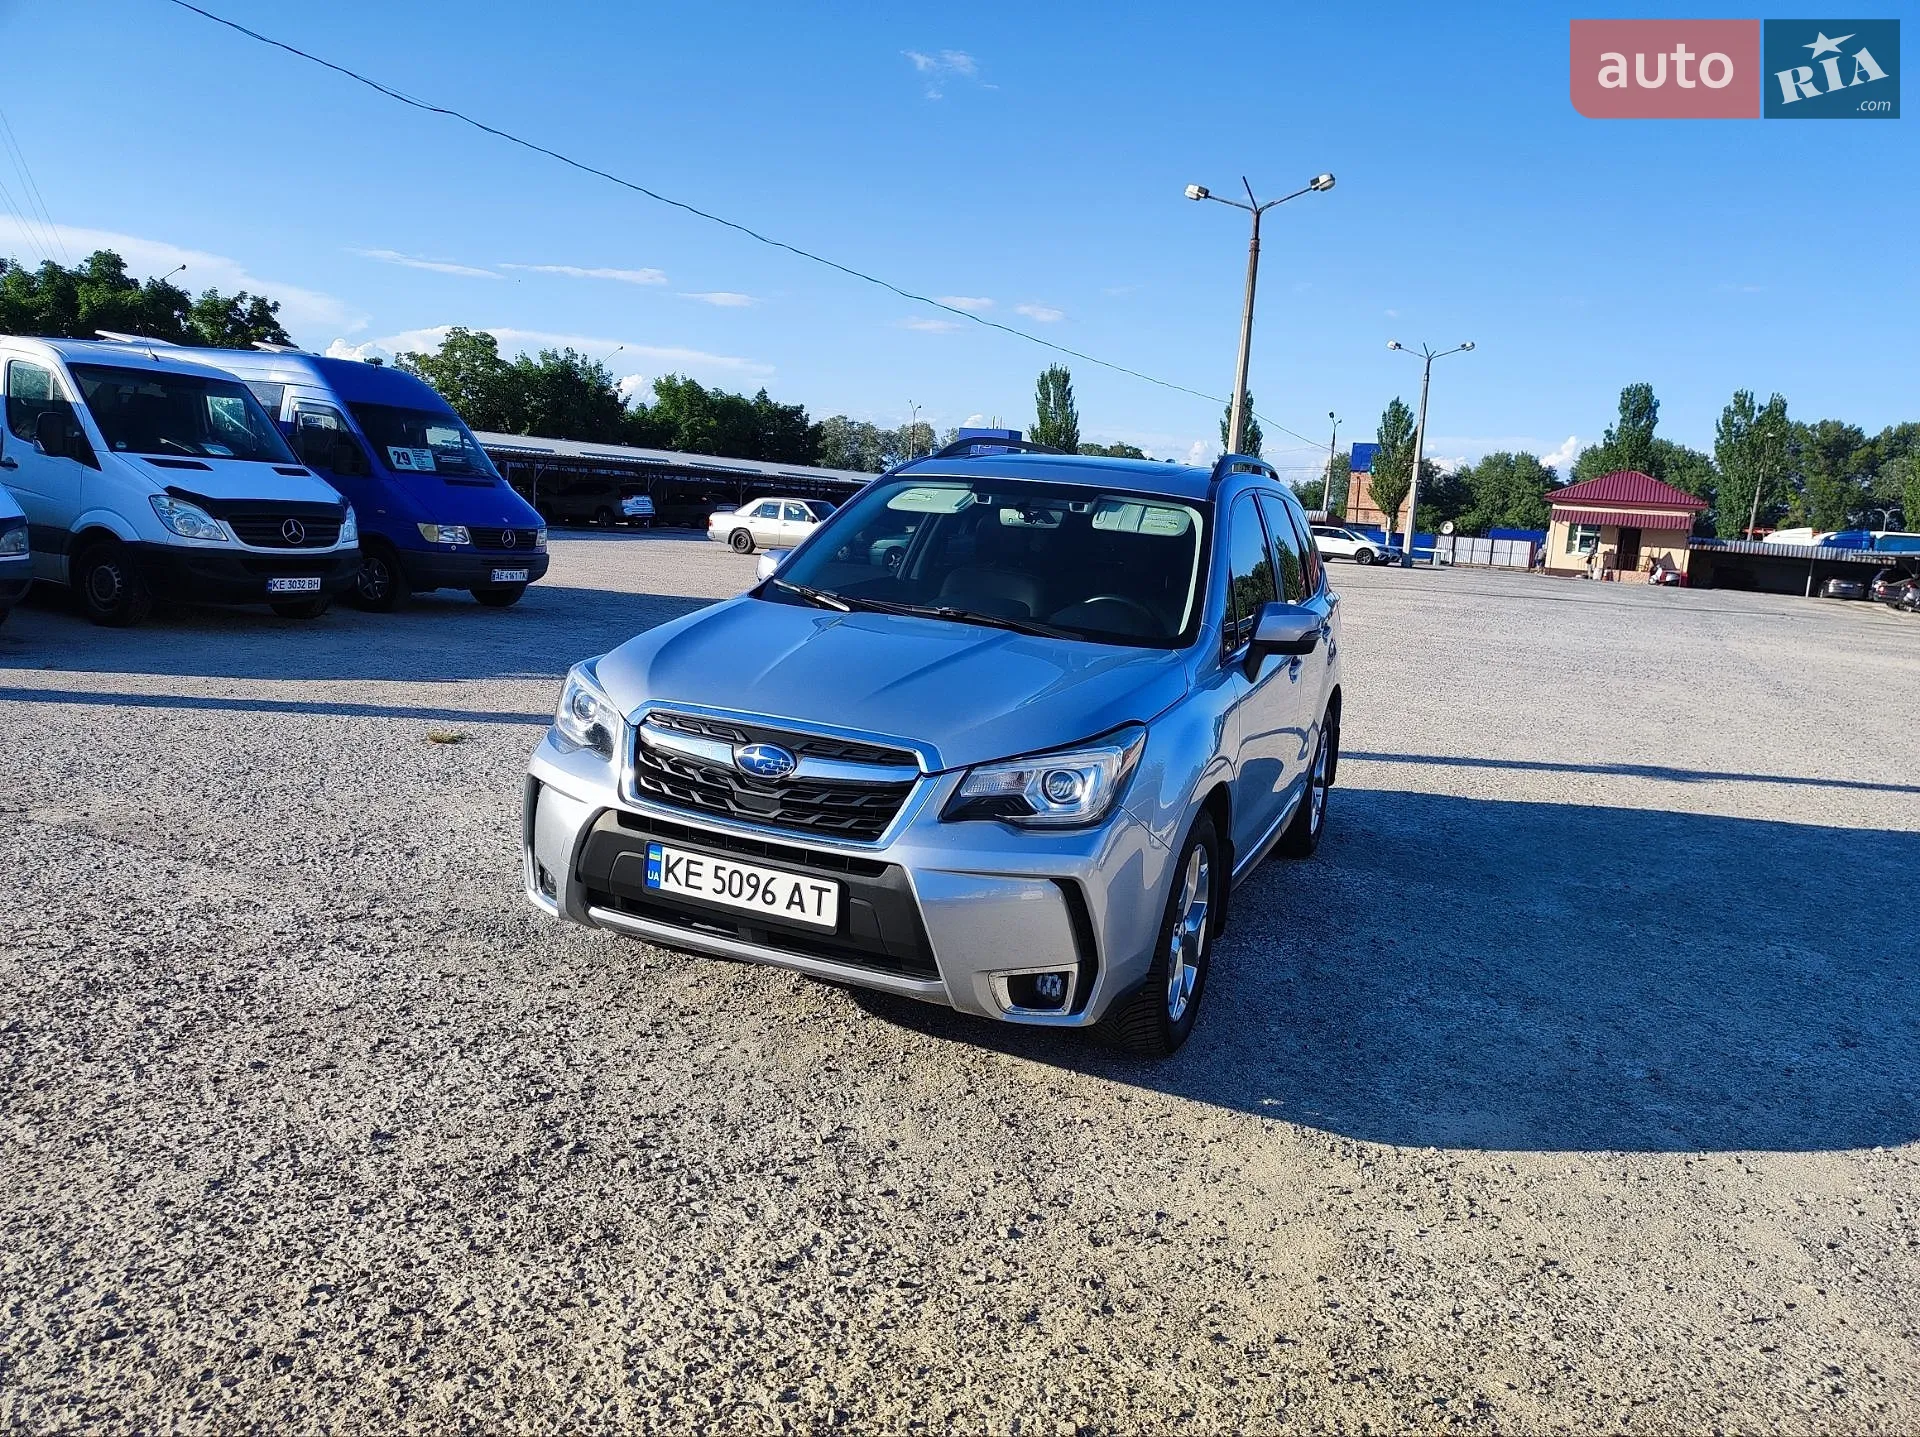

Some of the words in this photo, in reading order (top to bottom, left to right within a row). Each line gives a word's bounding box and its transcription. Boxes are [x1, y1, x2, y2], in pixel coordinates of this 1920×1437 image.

[393, 450, 412, 465] 29
[273, 579, 285, 590] KE
[287, 579, 306, 590] 3032
[307, 579, 319, 589] BH
[647, 869, 660, 881] UA
[664, 854, 704, 891] KE
[712, 865, 777, 906] 5096
[786, 882, 832, 917] AT
